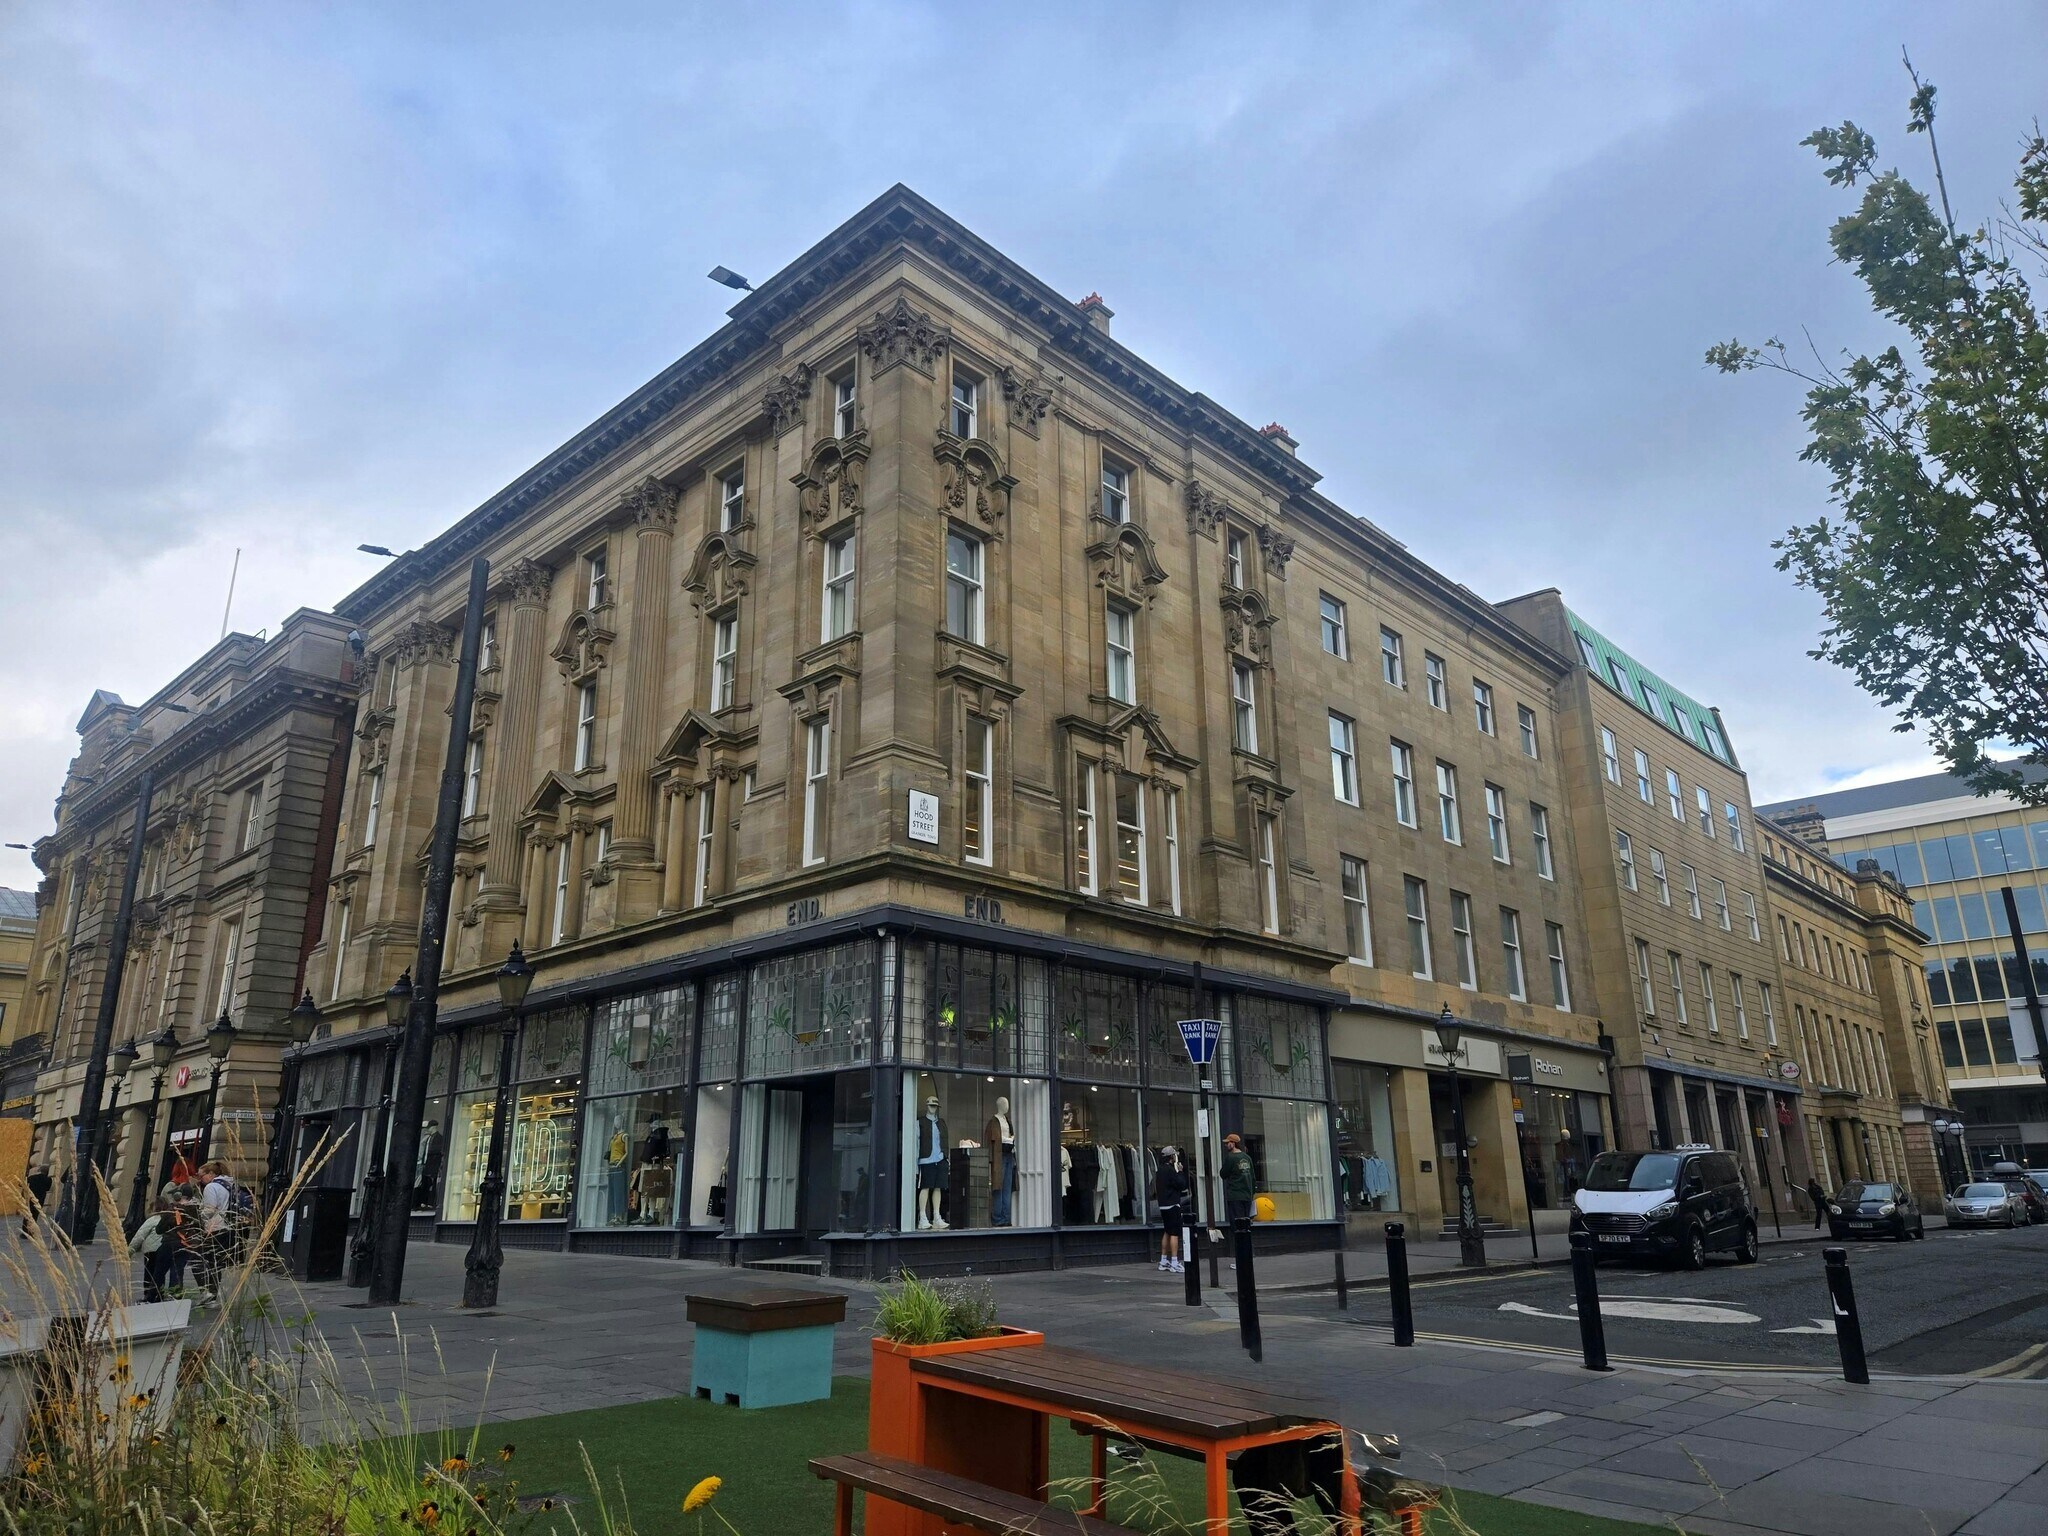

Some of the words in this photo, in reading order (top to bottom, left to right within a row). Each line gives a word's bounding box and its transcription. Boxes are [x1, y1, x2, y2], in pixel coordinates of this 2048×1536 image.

[914, 810, 934, 821] HOOD
[912, 820, 935, 832] STREET
[786, 897, 824, 926] END.
[964, 895, 1006, 924] END.
[1183, 1023, 1201, 1032] TAXI
[1206, 1023, 1219, 1031] TAXI
[1184, 1031, 1201, 1039] RANK
[1205, 1031, 1217, 1039] RANK
[1534, 1058, 1563, 1076] Rohan
